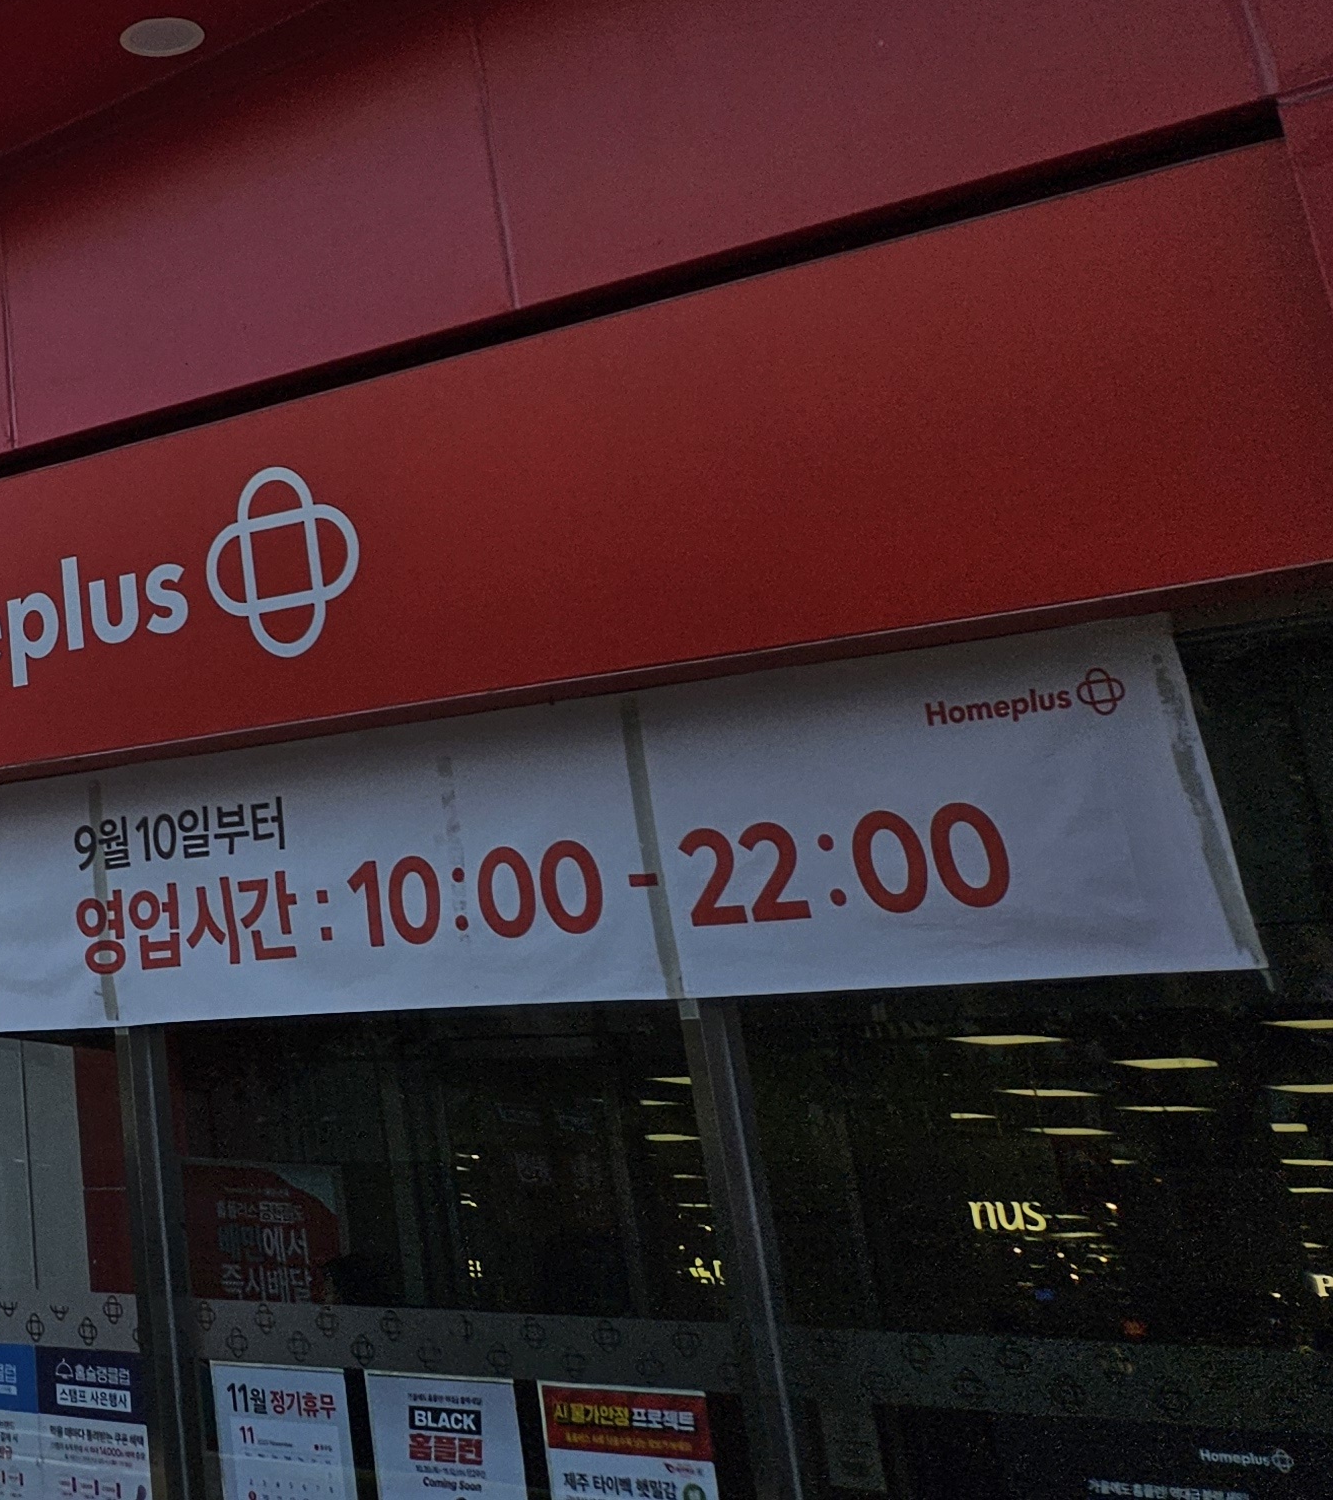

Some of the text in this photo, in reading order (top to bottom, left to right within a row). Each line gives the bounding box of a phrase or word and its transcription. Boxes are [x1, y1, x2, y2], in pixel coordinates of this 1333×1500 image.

[925, 689, 1072, 726] Homeplus
[76, 870, 298, 975] 영업시간
[347, 840, 603, 947] 10:00
[678, 802, 1010, 927] 22:00
[220, 1263, 313, 1304] 즉시배달
[59, 1387, 128, 1409] 스탬프 사은행사
[227, 1382, 336, 1420] 11월 정기휴무
[414, 1410, 476, 1431] BLACK
[570, 1403, 630, 1427] 물가안정
[632, 1407, 696, 1432] 프로젝트
[239, 1426, 255, 1444] 11
[409, 1433, 483, 1466] 홈플런
[1199, 1449, 1271, 1467] Homeplus
[423, 1476, 482, 1492] Coming Soon
[563, 1472, 589, 1492] 제주
[593, 1474, 633, 1497] 타이백
